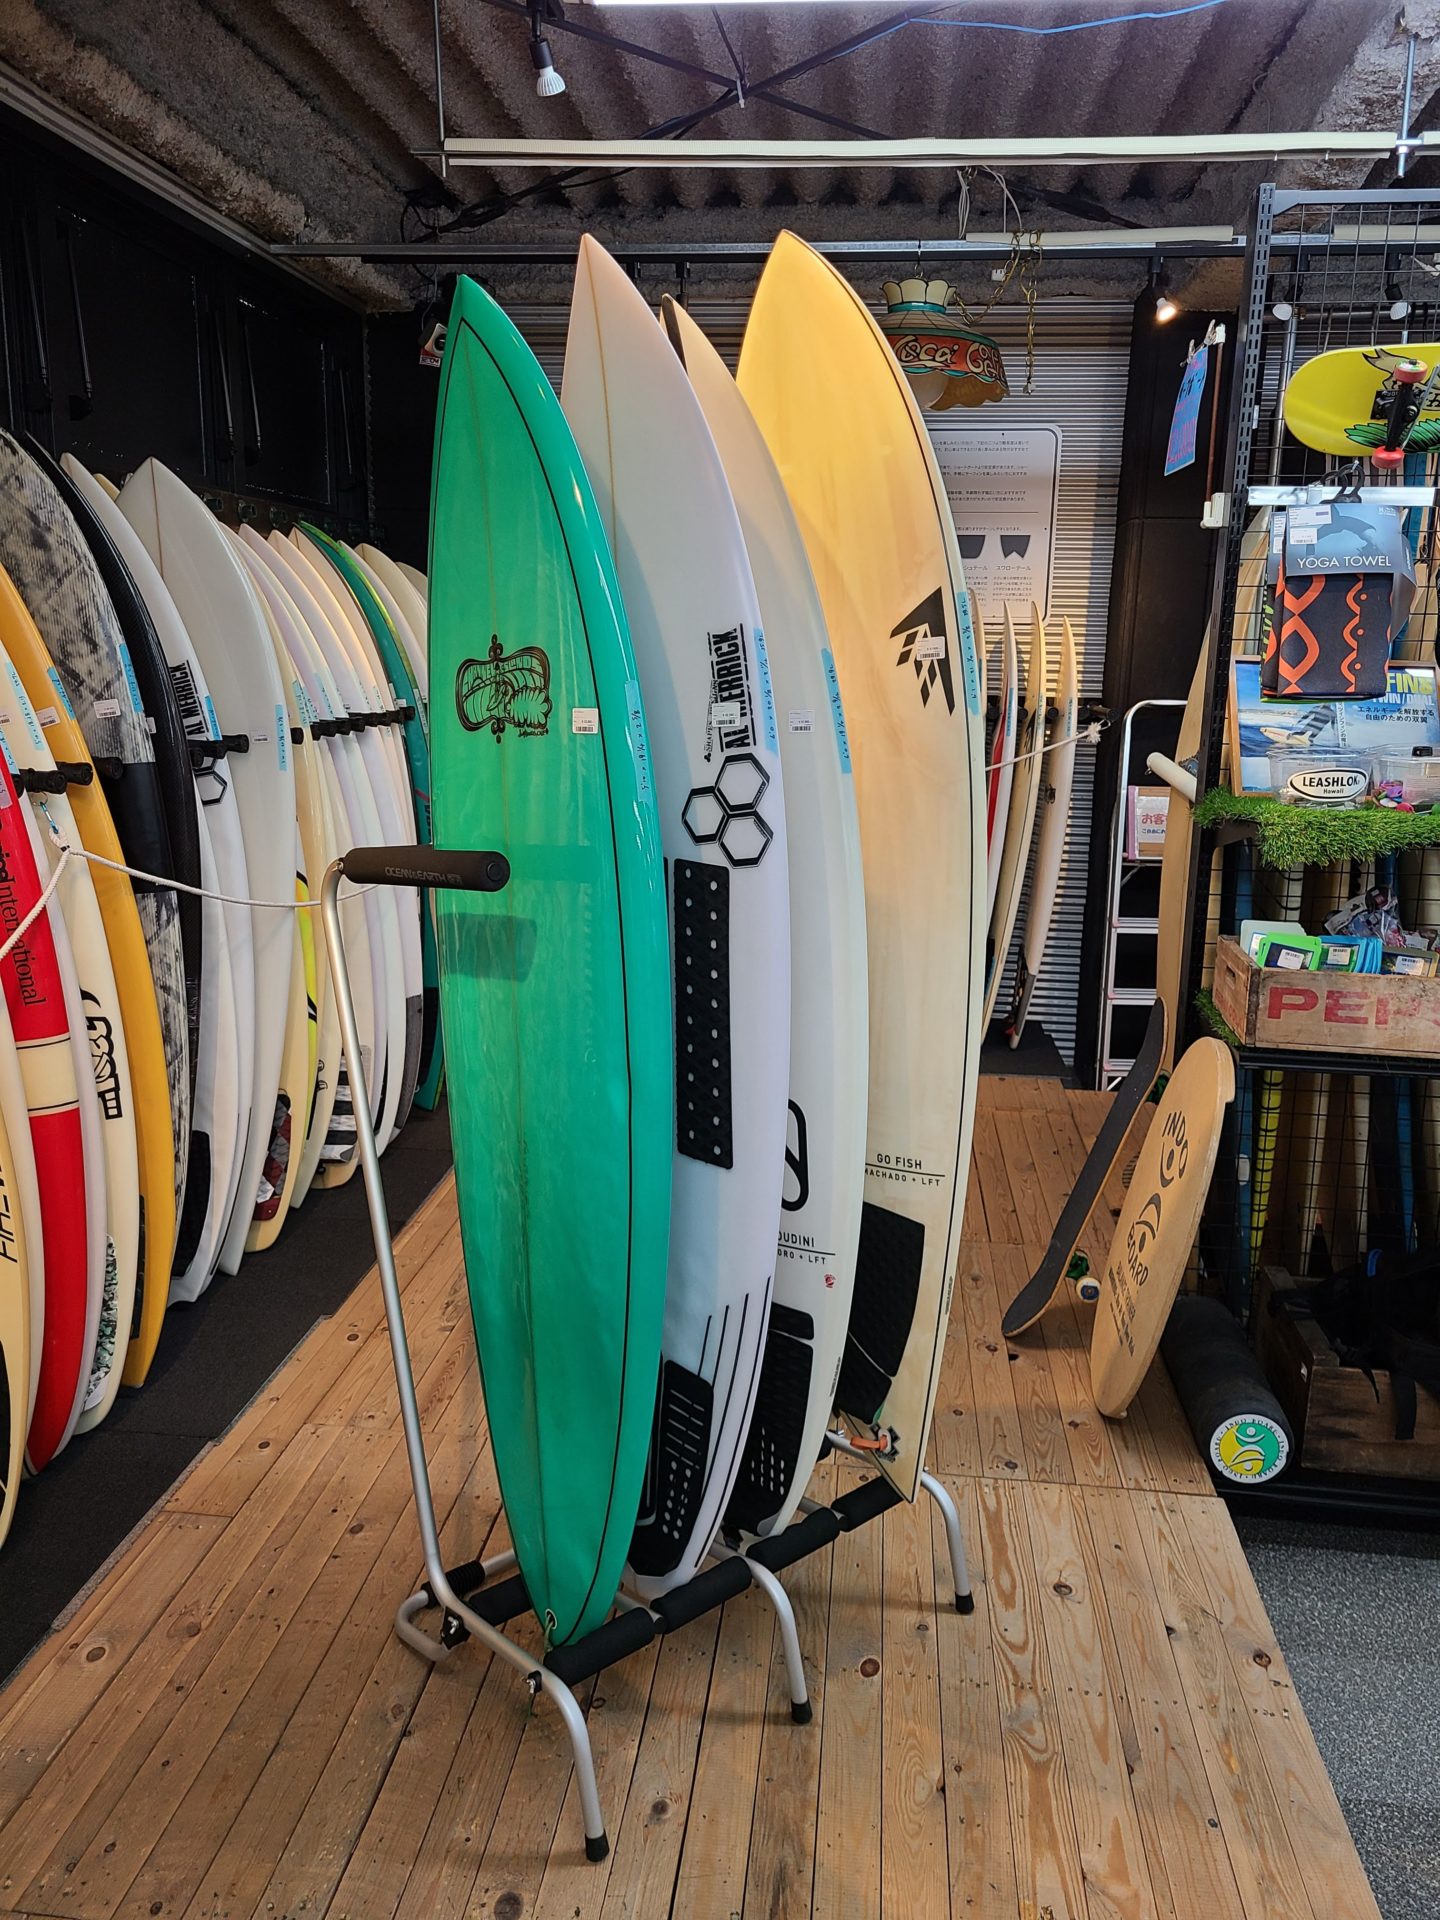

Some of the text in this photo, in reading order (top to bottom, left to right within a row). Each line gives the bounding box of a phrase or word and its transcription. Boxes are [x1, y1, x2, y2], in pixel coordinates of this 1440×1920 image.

[1297, 556, 1340, 569] YOGA
[1343, 555, 1392, 567] TOWEL
[170, 663, 205, 735] AL MERRICK
[1358, 705, 1435, 717] エネルギーを解放する
[724, 725, 750, 748] AL
[1302, 774, 1358, 788] LEASHLOK
[1141, 813, 1167, 825] お客
[1162, 1110, 1188, 1180] INDO
[876, 1153, 922, 1170] GO FISH
[922, 1177, 940, 1187] LFT
[808, 1254, 826, 1265] LFT
[1127, 1221, 1149, 1287] BOARD
